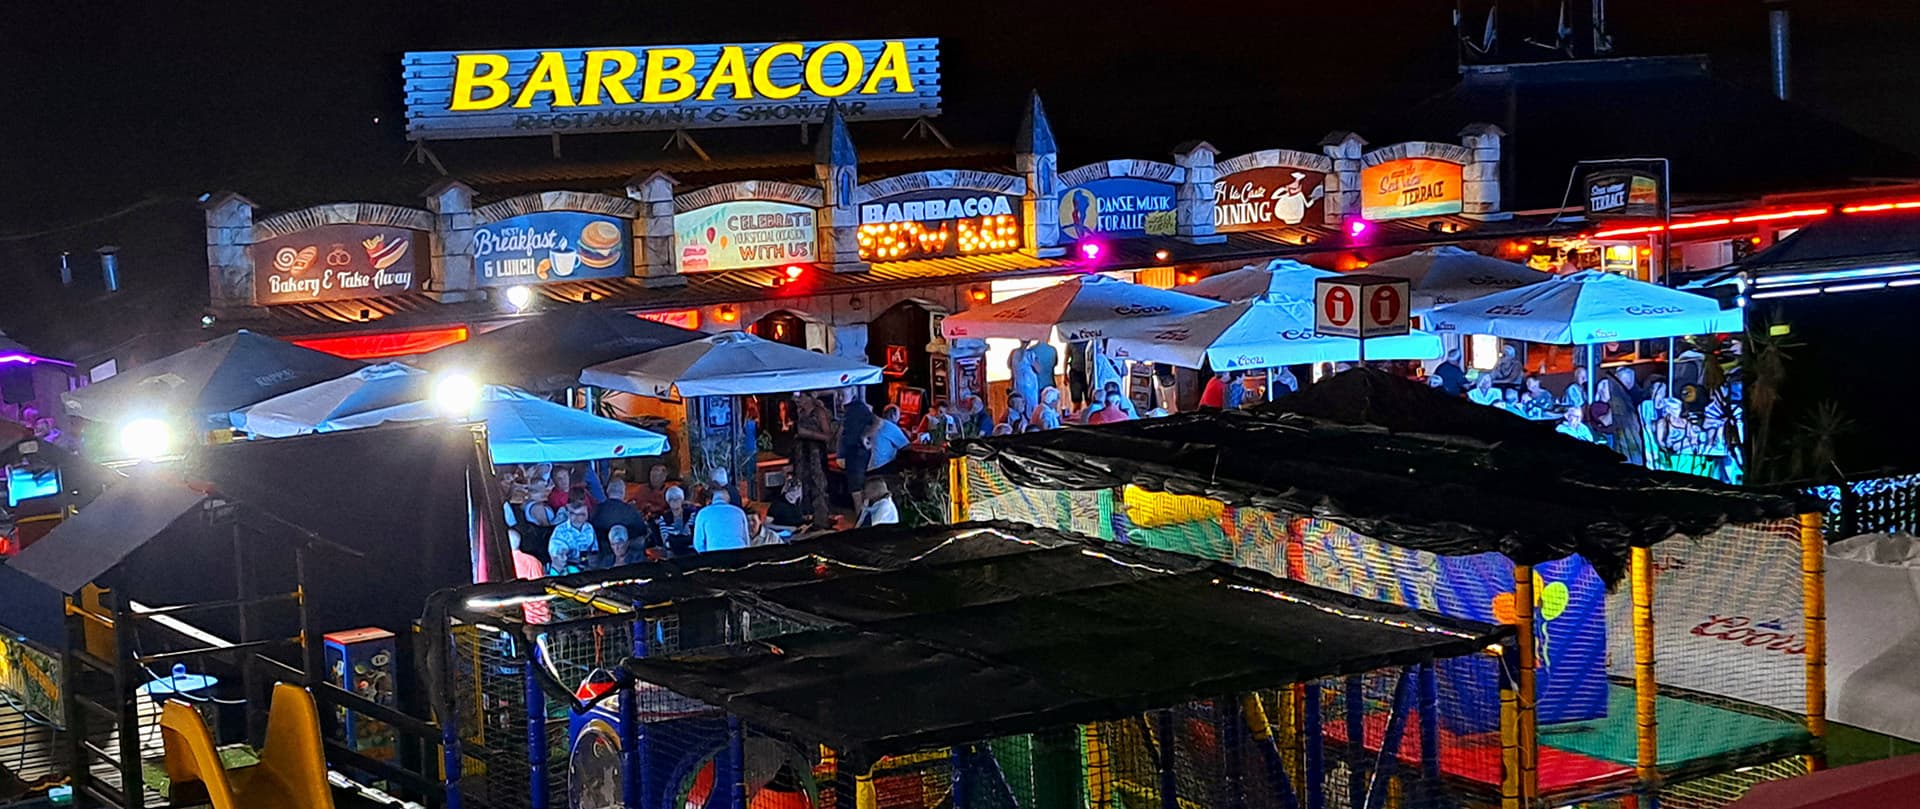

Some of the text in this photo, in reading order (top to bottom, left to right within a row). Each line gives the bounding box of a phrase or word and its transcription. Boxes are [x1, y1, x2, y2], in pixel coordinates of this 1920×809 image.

[449, 41, 916, 111] BARBACOA
[515, 108, 699, 129] RESTAURANT
[705, 107, 728, 122] &
[1097, 196, 1172, 213] DANSE MUSIK
[1402, 181, 1444, 207] TERRACE
[727, 212, 812, 231] CELEBRATE
[862, 196, 1012, 224] BARBACOA
[1214, 201, 1272, 226] DINING
[857, 213, 1019, 258] SHOW BAR
[1097, 214, 1119, 232] FOR
[473, 227, 557, 258] Breakfast
[739, 243, 785, 261] WITH
[496, 257, 535, 277] LUNCH
[269, 275, 319, 297] Bakery
[337, 271, 370, 289] Take
[371, 268, 412, 290] Away
[1625, 304, 1684, 316] Coors
[1690, 615, 1808, 655] Coors
